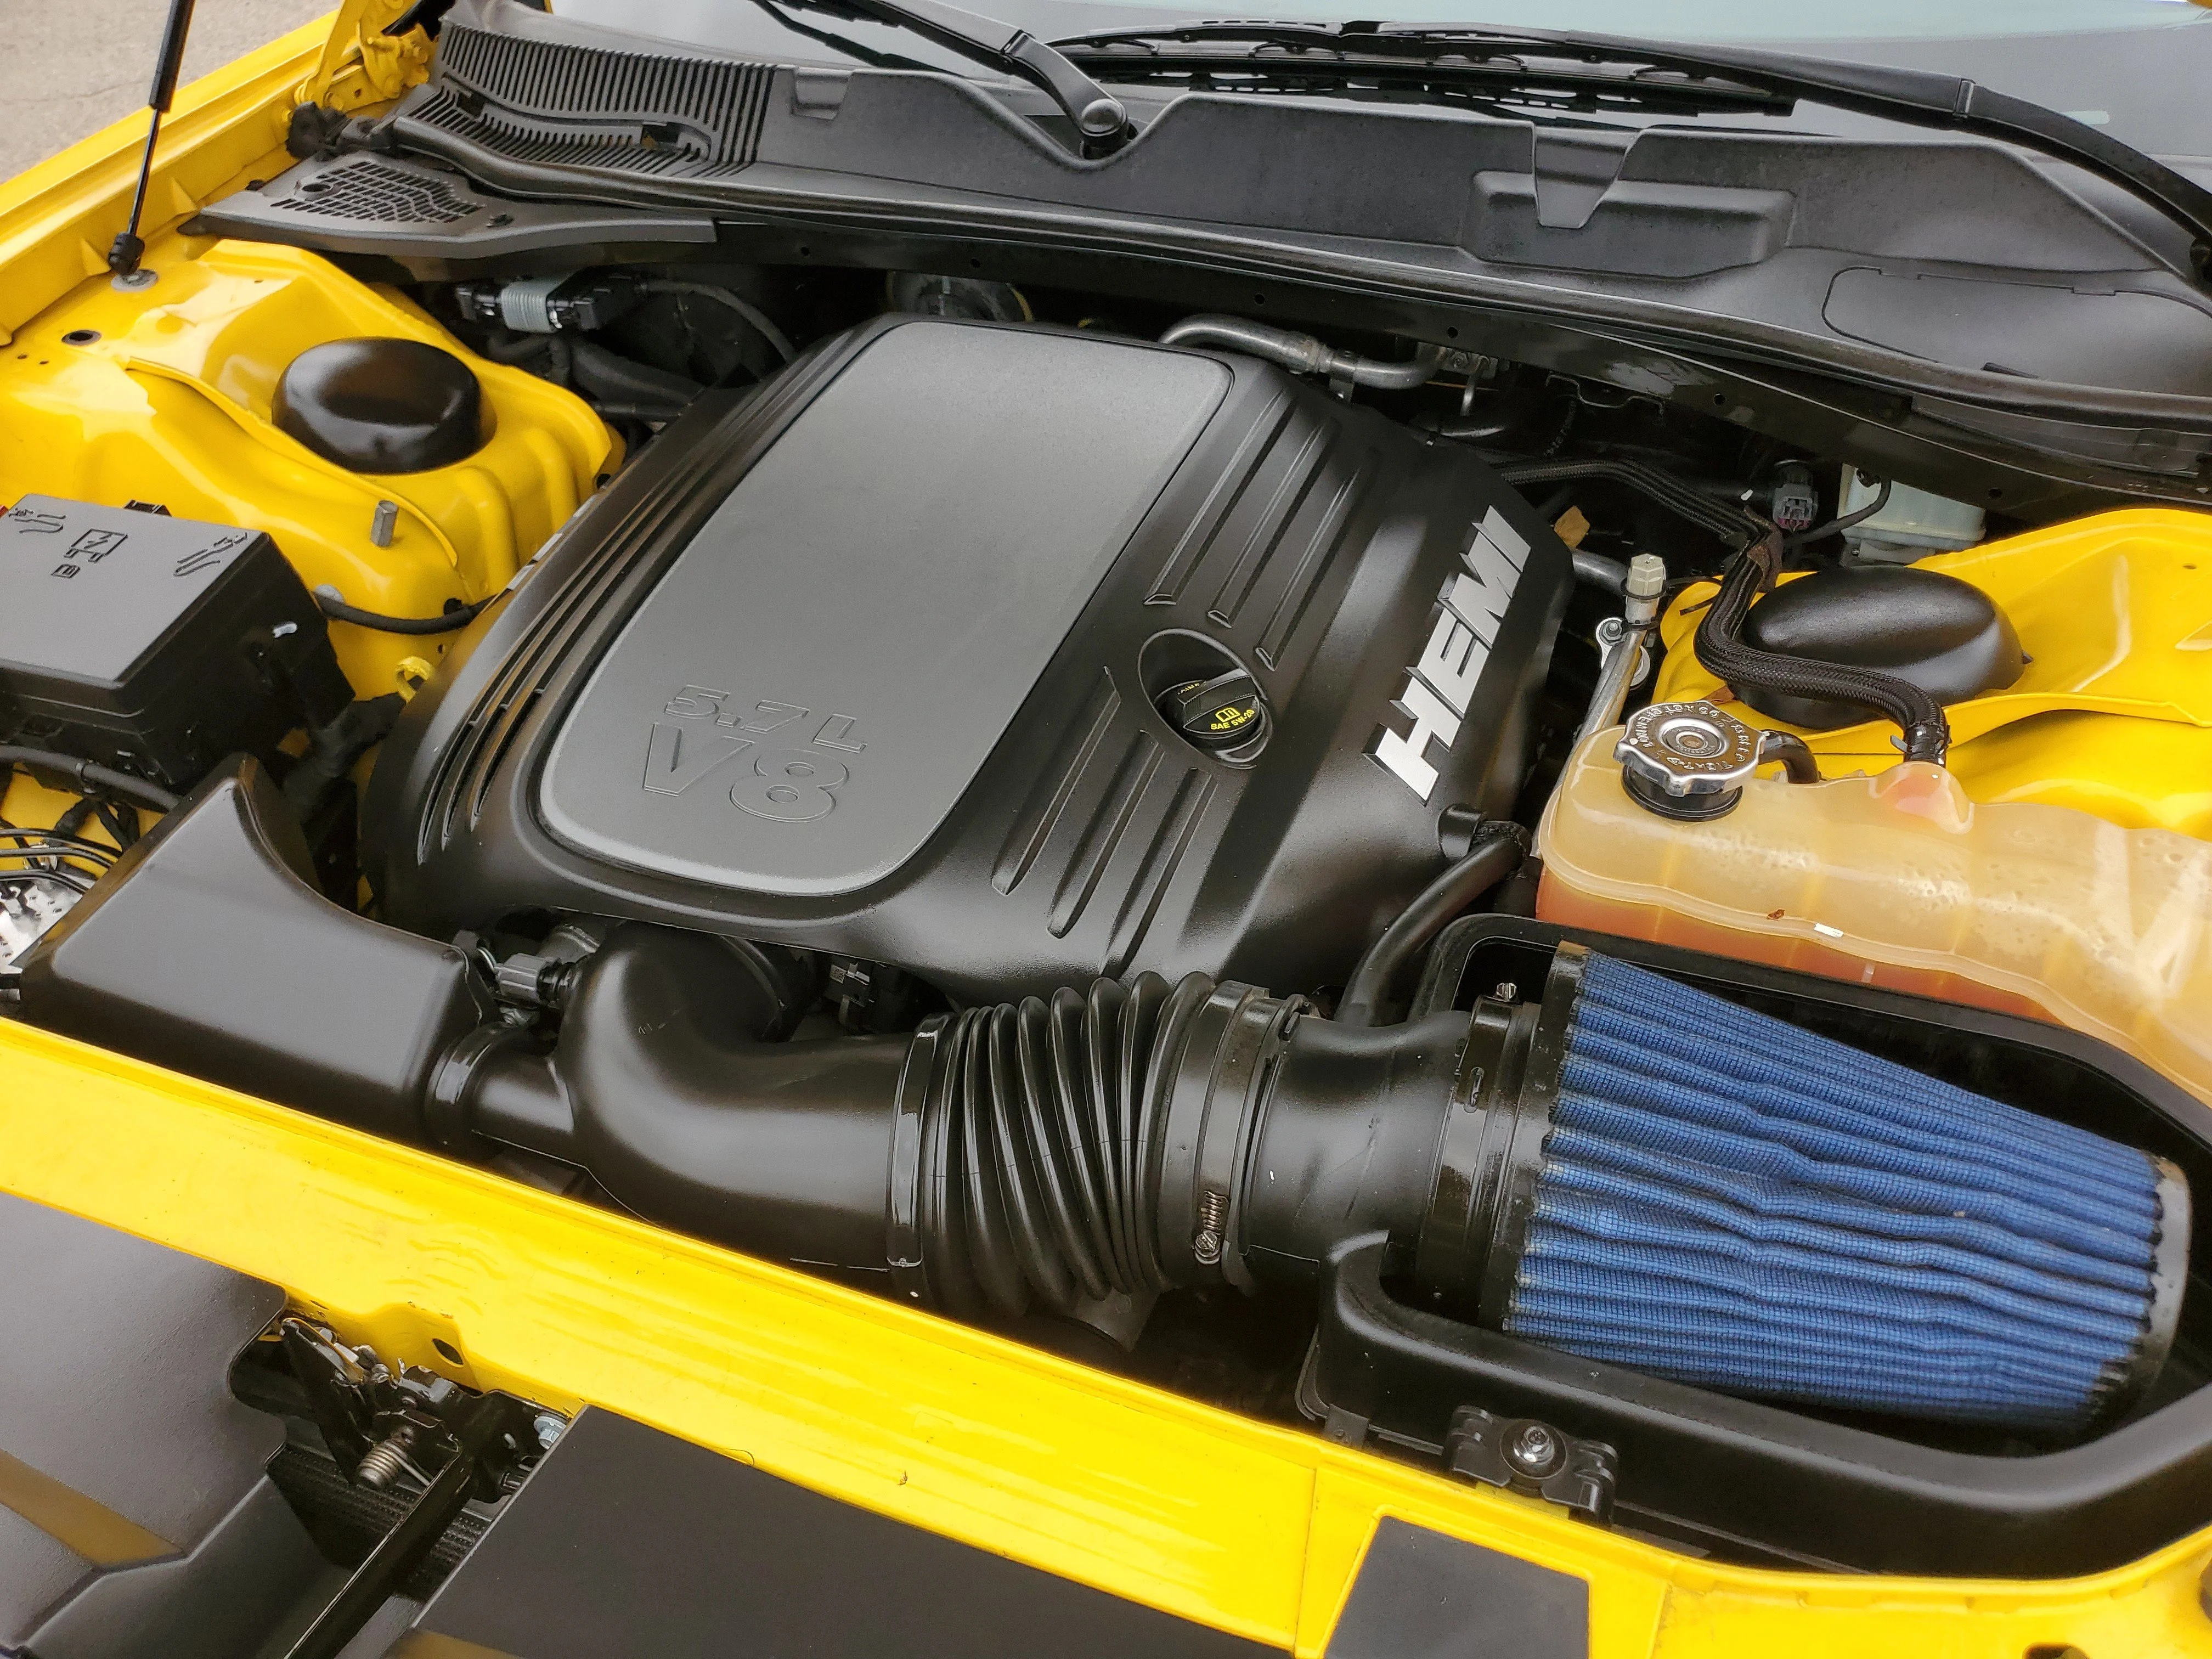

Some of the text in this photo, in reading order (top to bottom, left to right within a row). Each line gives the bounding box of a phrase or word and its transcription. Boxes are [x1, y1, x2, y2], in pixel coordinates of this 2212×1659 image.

[1362, 505, 1531, 806] HEMI
[664, 685, 867, 753] 5.7L
[1210, 709, 1255, 730] SAE 5W-20
[642, 722, 850, 823] V8
[1683, 760, 1734, 771] TIGHT
